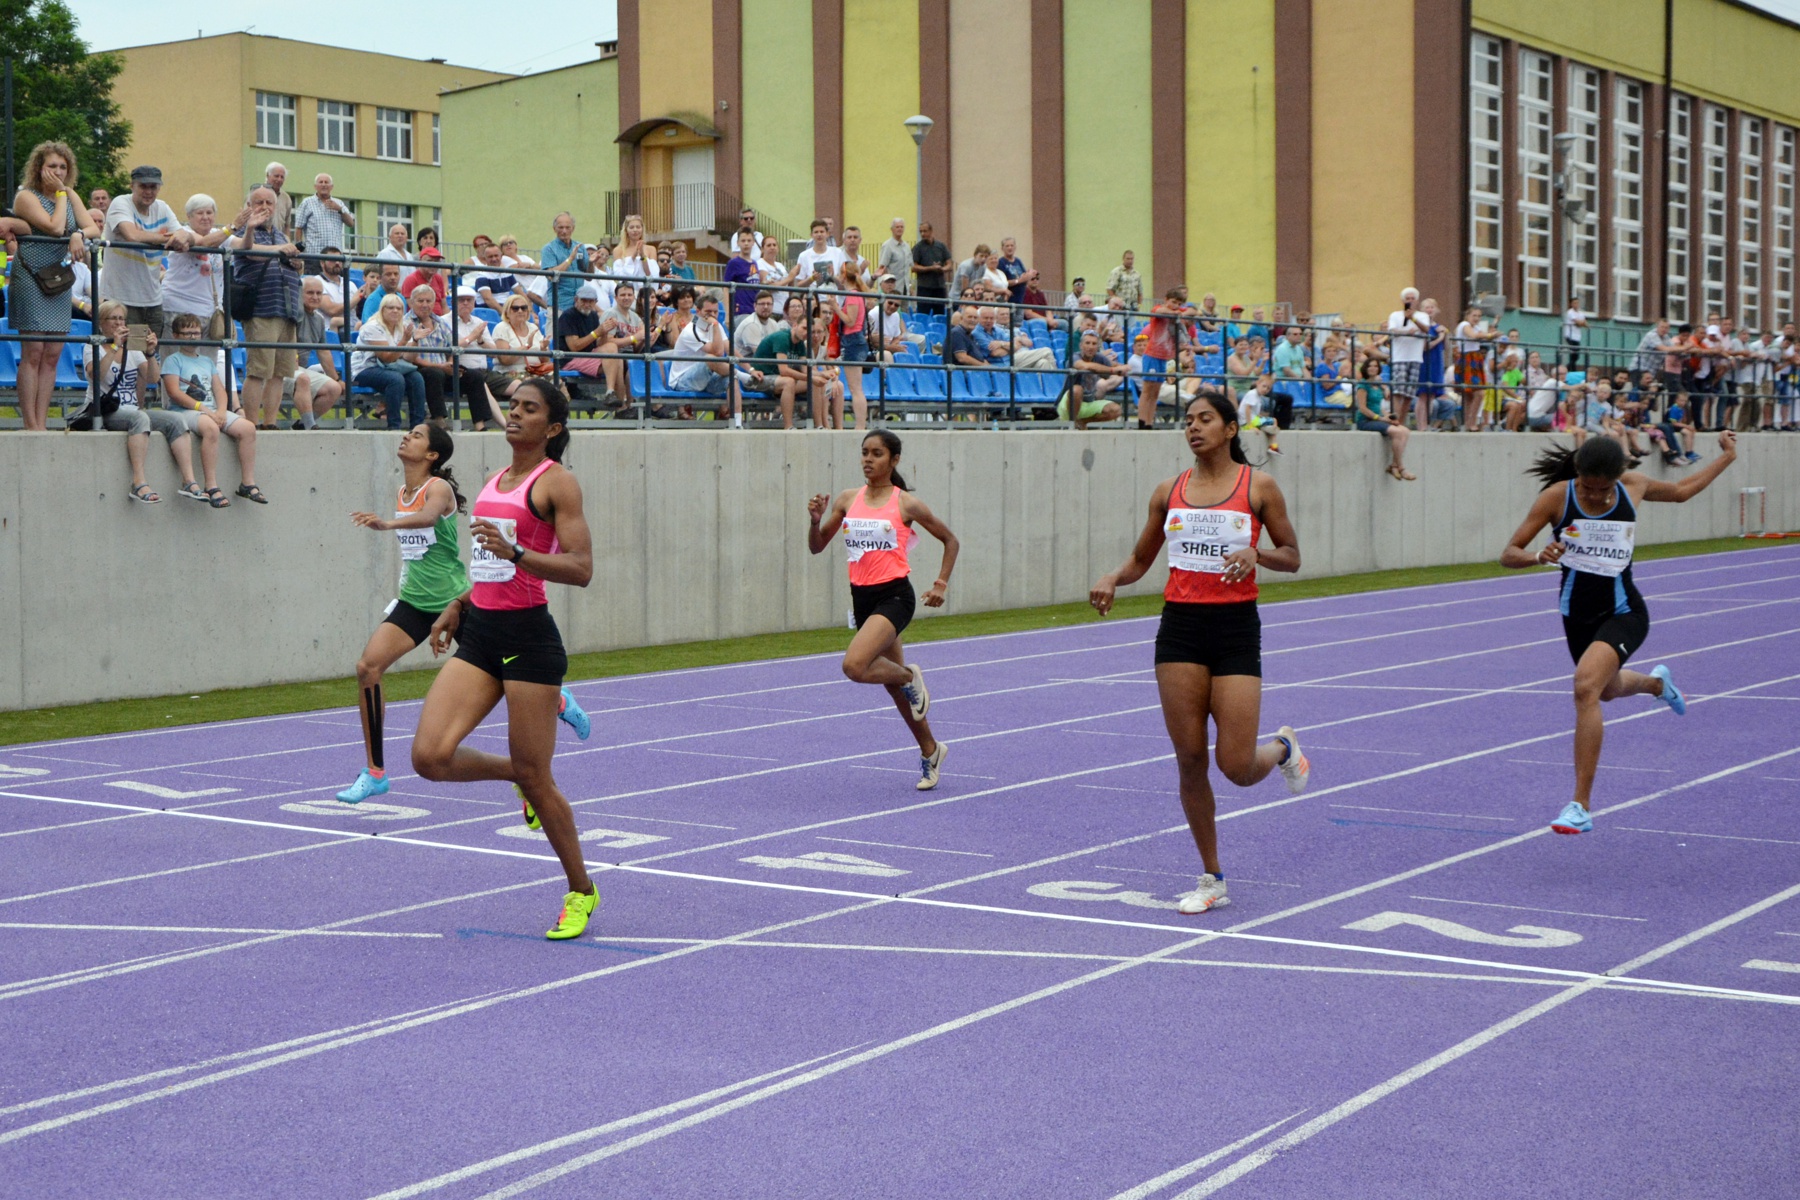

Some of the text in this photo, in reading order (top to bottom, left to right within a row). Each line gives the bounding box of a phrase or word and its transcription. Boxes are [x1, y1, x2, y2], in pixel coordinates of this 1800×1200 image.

[1186, 513, 1226, 524] GRAND
[851, 520, 879, 529] GRAND
[1583, 522, 1622, 532] GRAND
[1192, 526, 1219, 536] PRIX
[1588, 533, 1615, 542] PRIX
[1182, 542, 1229, 557] SHREE
[739, 850, 910, 878] 4
[1026, 879, 1186, 911] 3
[1341, 911, 1583, 949] 2
